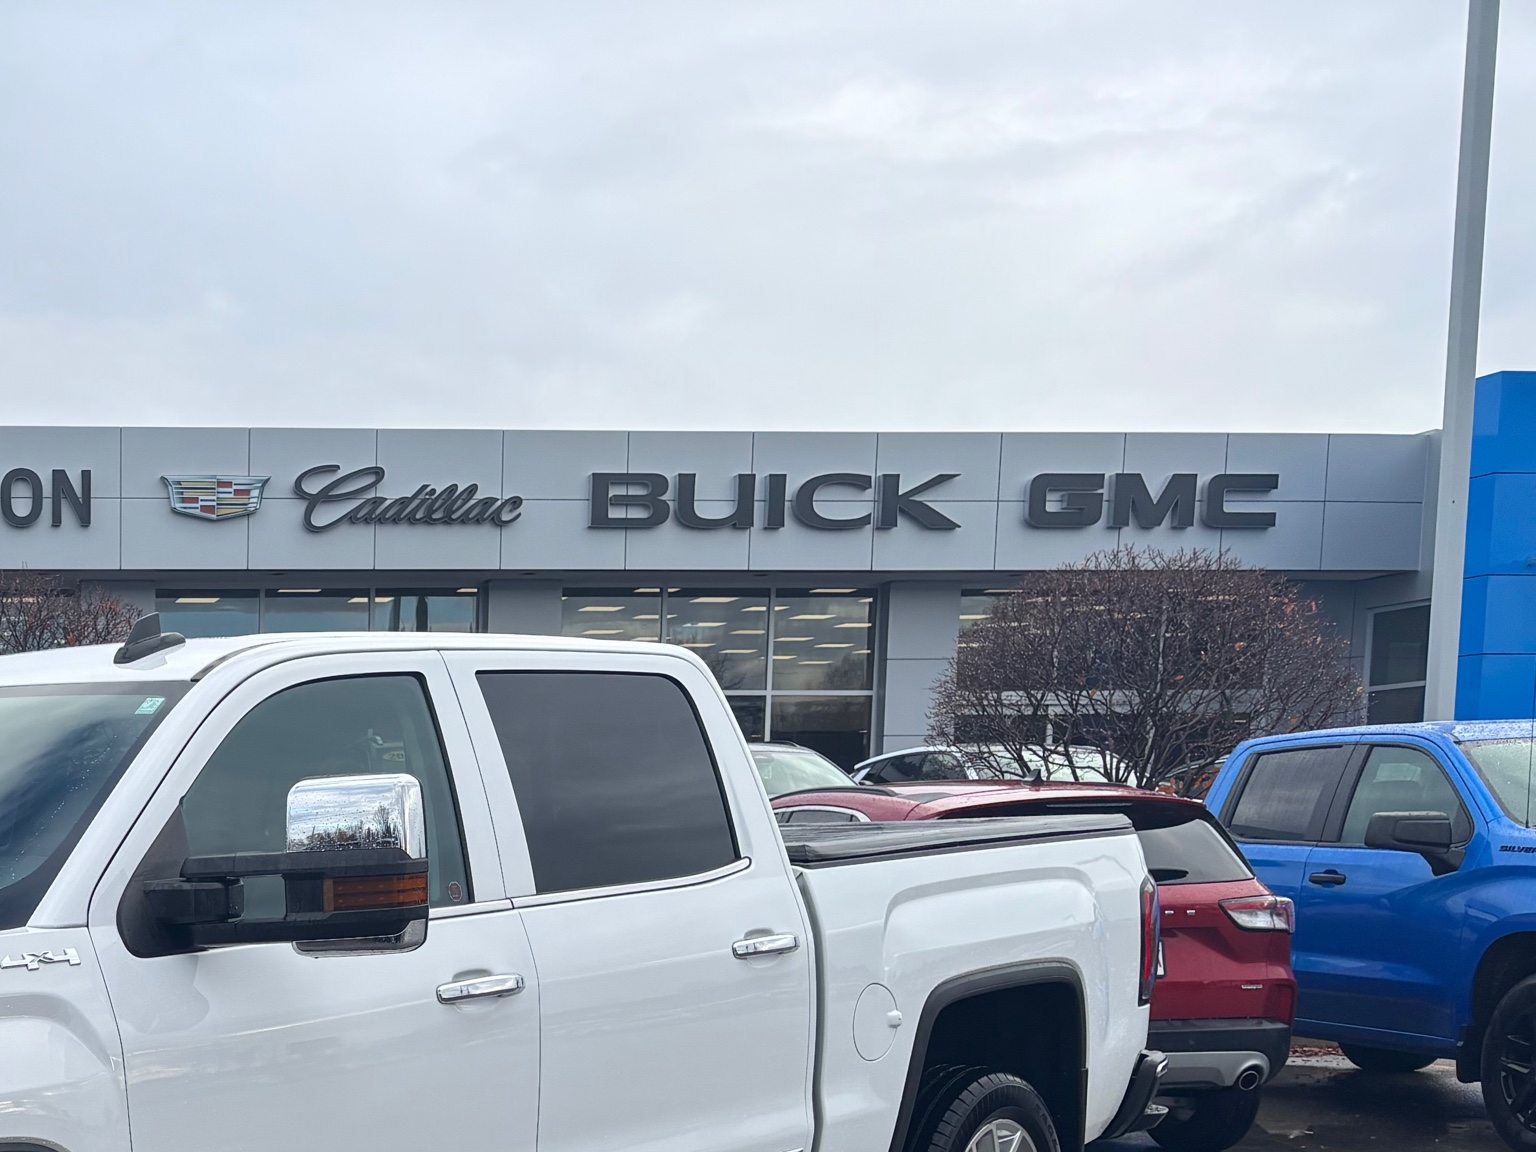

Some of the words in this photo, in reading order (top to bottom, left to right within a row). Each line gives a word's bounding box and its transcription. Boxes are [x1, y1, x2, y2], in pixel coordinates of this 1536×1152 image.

[293, 464, 524, 533] Cadillac
[587, 472, 963, 529] BUICK
[1023, 472, 1280, 529] GMC
